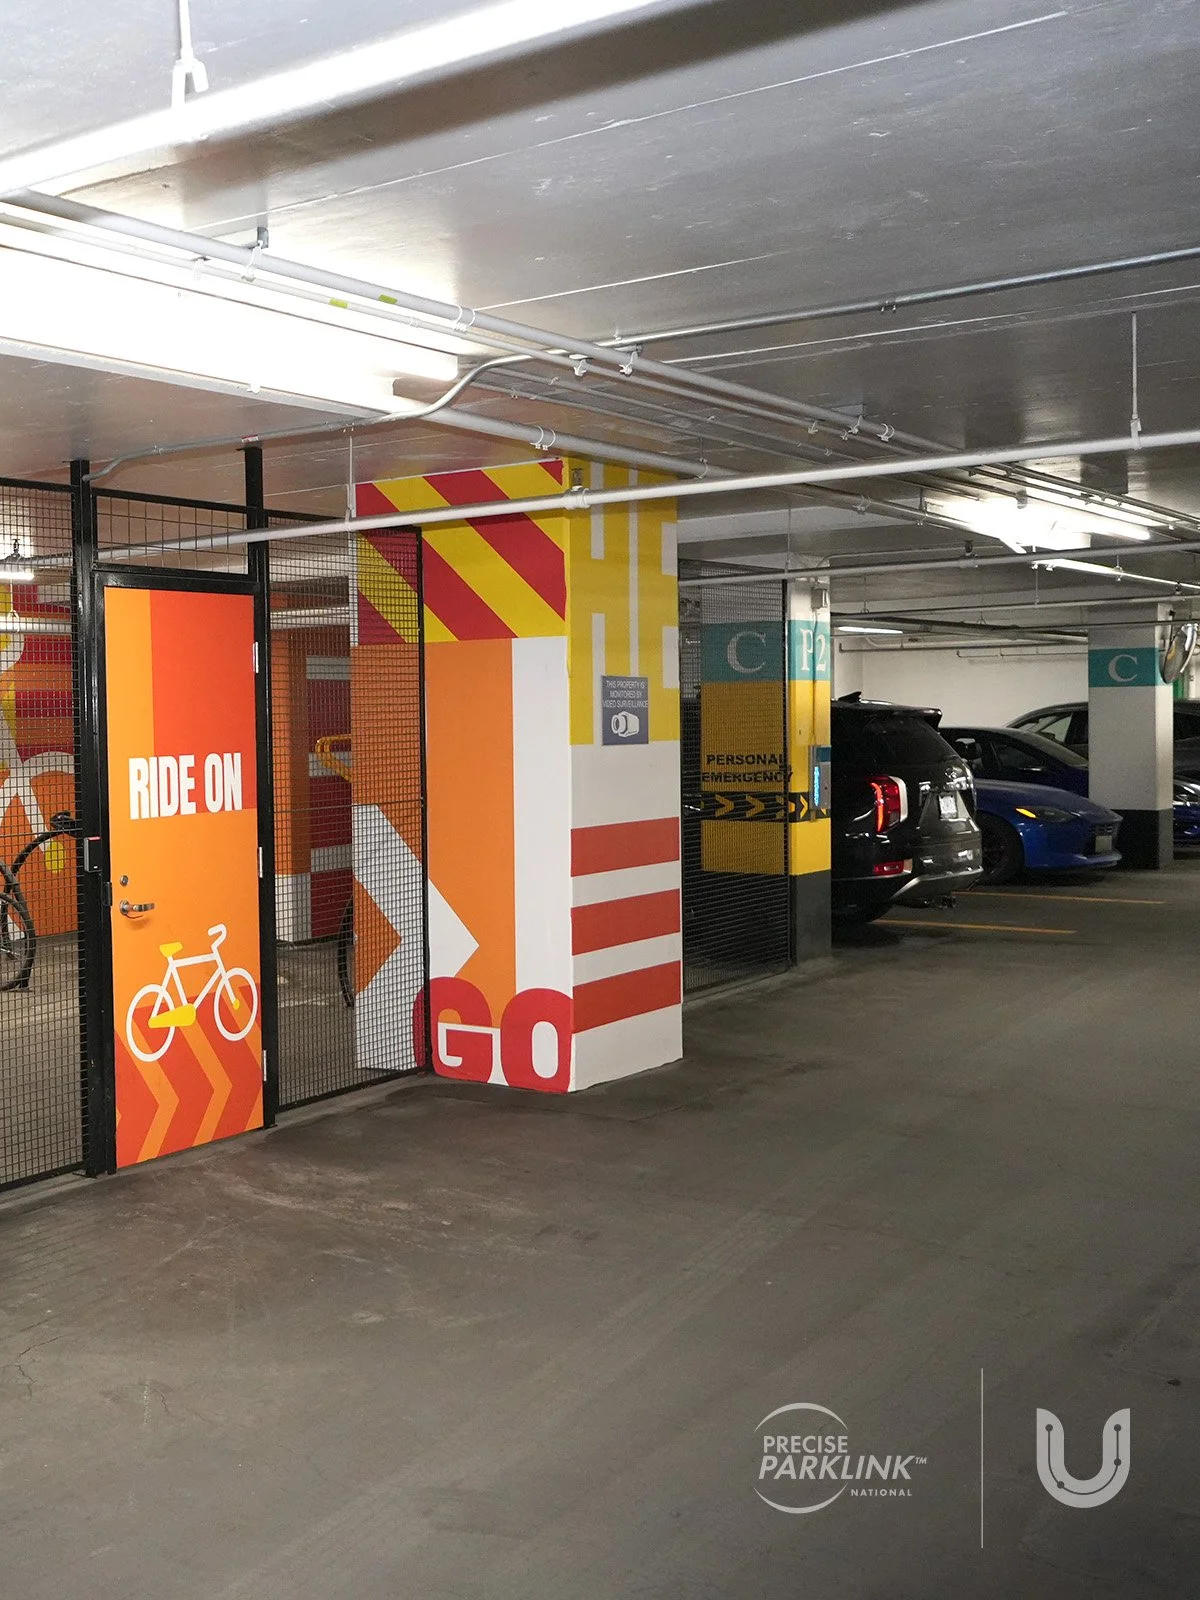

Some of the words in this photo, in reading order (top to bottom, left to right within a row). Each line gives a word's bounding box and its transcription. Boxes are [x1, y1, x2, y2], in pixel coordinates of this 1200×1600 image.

[727, 631, 766, 673] C
[800, 628, 827, 672] P2
[1108, 654, 1138, 683] C
[606, 680, 616, 688] THIS
[617, 681, 639, 689] PROPERTY
[609, 690, 636, 699] MONITORED
[603, 700, 616, 708] VIDEO
[617, 700, 648, 708] SURVEILLANCE
[128, 754, 197, 820] RIDE
[204, 752, 243, 814] ON
[702, 771, 793, 783] EMERGENCY
[412, 976, 574, 1094] GO
